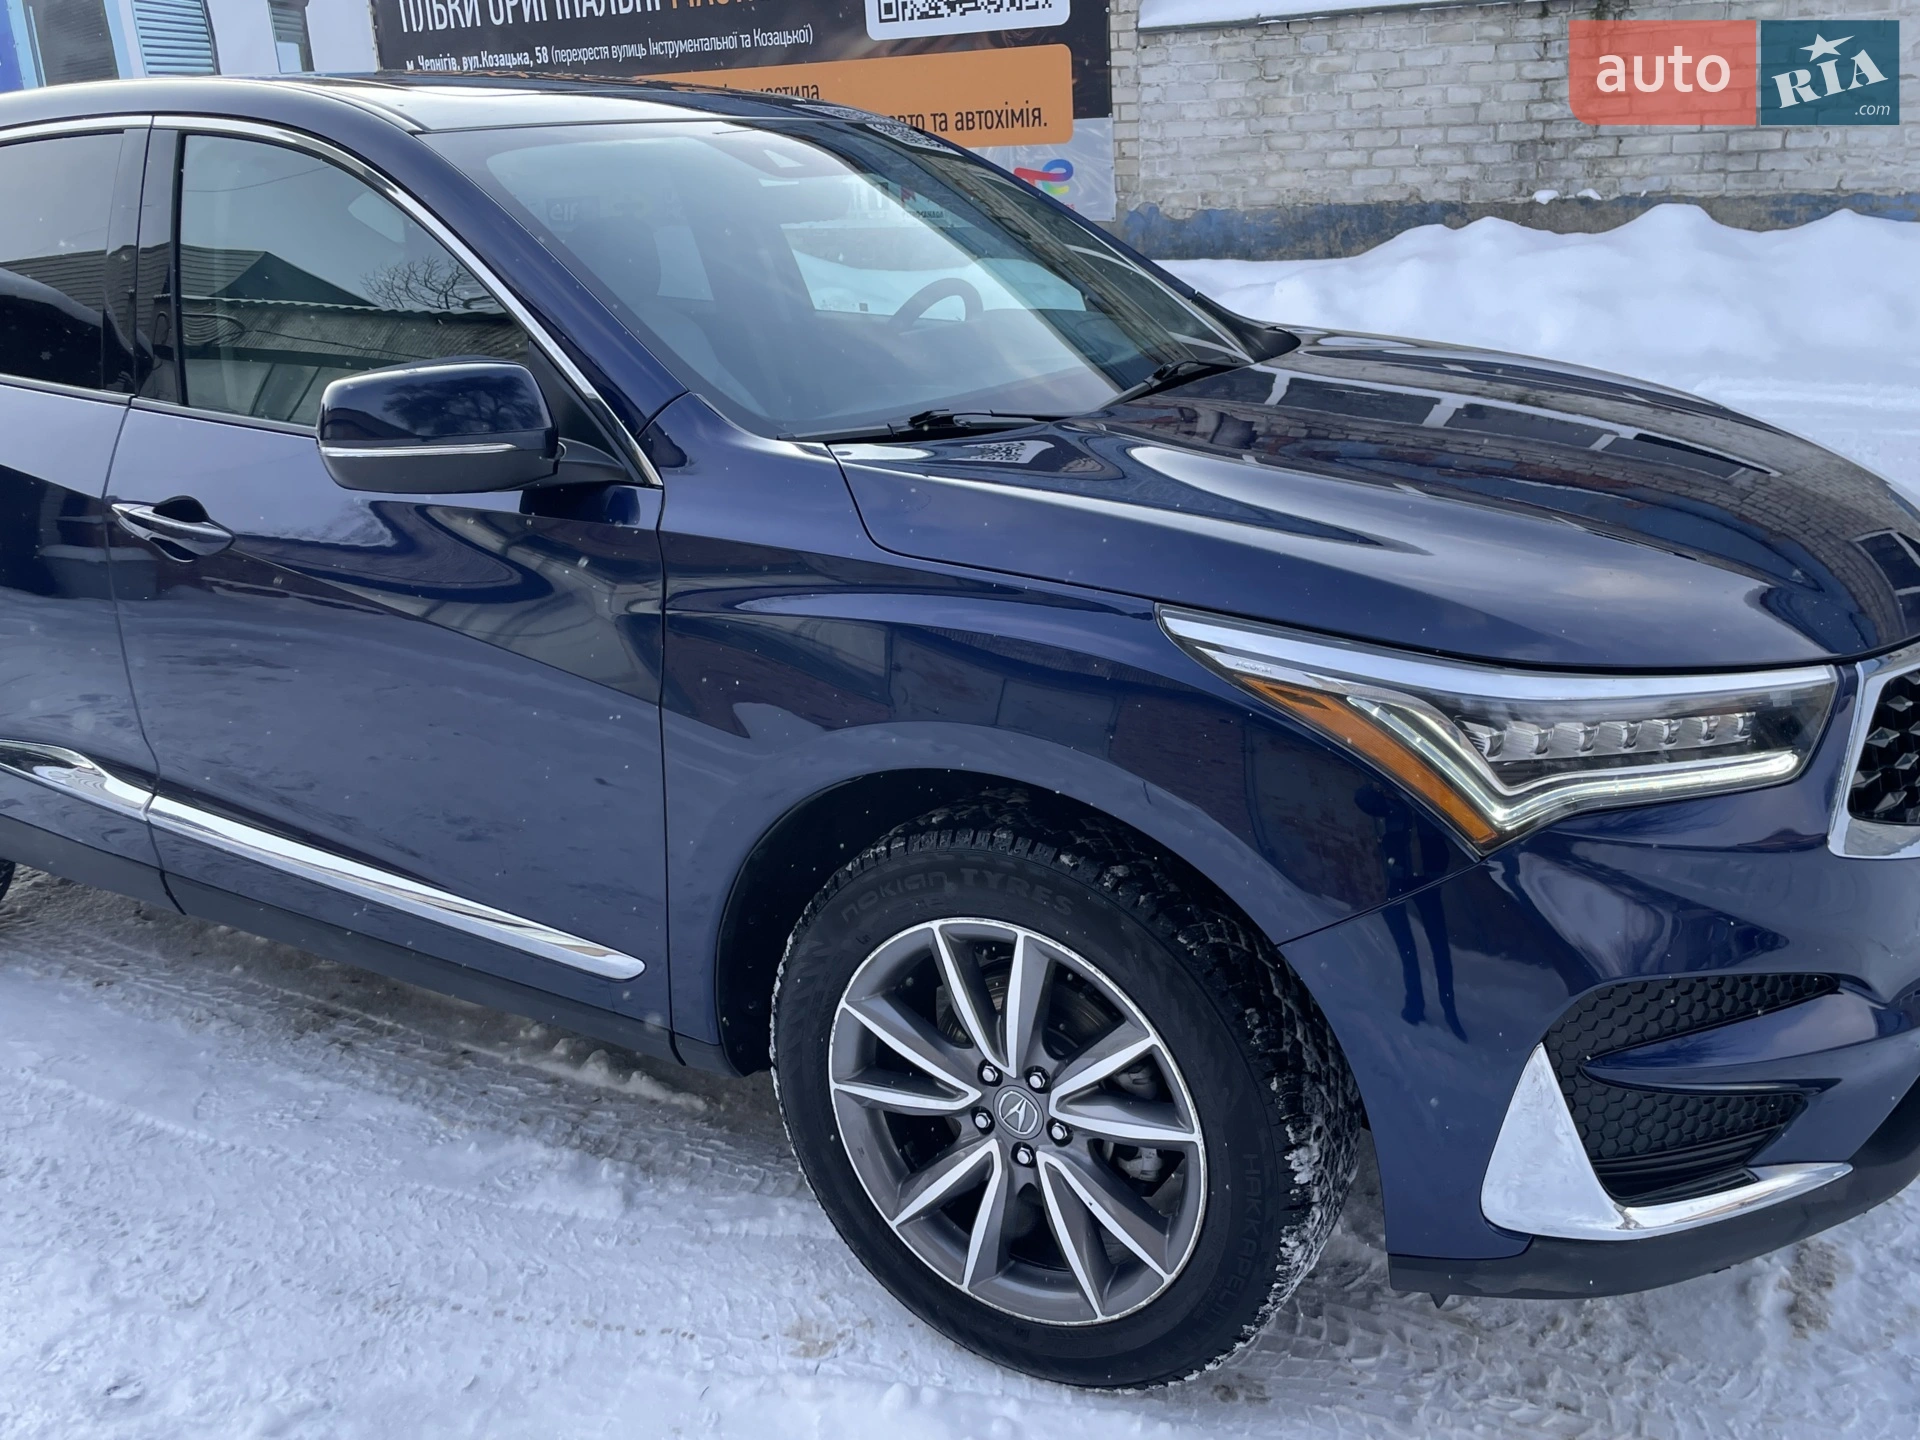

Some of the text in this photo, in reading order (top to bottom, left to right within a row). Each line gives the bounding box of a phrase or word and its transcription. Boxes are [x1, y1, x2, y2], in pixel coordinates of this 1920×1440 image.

[535, 46, 549, 64] 58
[551, 45, 609, 66] (перехрестя
[612, 45, 647, 63] вулиць
[648, 31, 738, 59] Інструментальної
[740, 34, 751, 49] та
[753, 23, 814, 48] Козацької)
[930, 112, 948, 132] та
[955, 100, 1048, 132] автохімія.
[549, 202, 579, 223] elf
[959, 867, 1075, 917] TYRES
